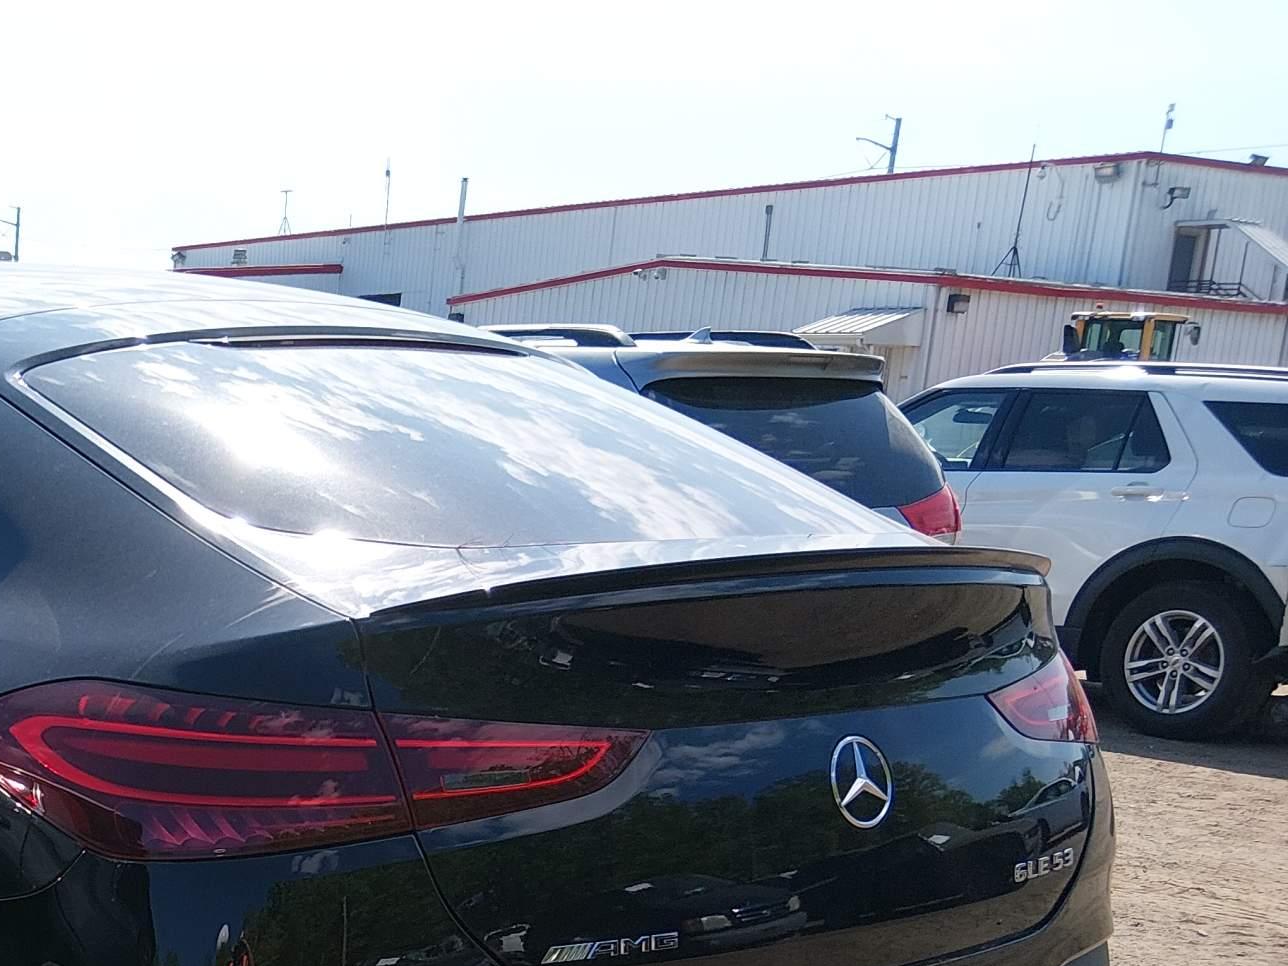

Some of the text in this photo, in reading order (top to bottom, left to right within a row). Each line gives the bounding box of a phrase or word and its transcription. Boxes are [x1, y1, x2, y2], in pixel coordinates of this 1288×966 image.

[1014, 847, 1074, 882] GLE 53
[587, 931, 678, 960] AMG
